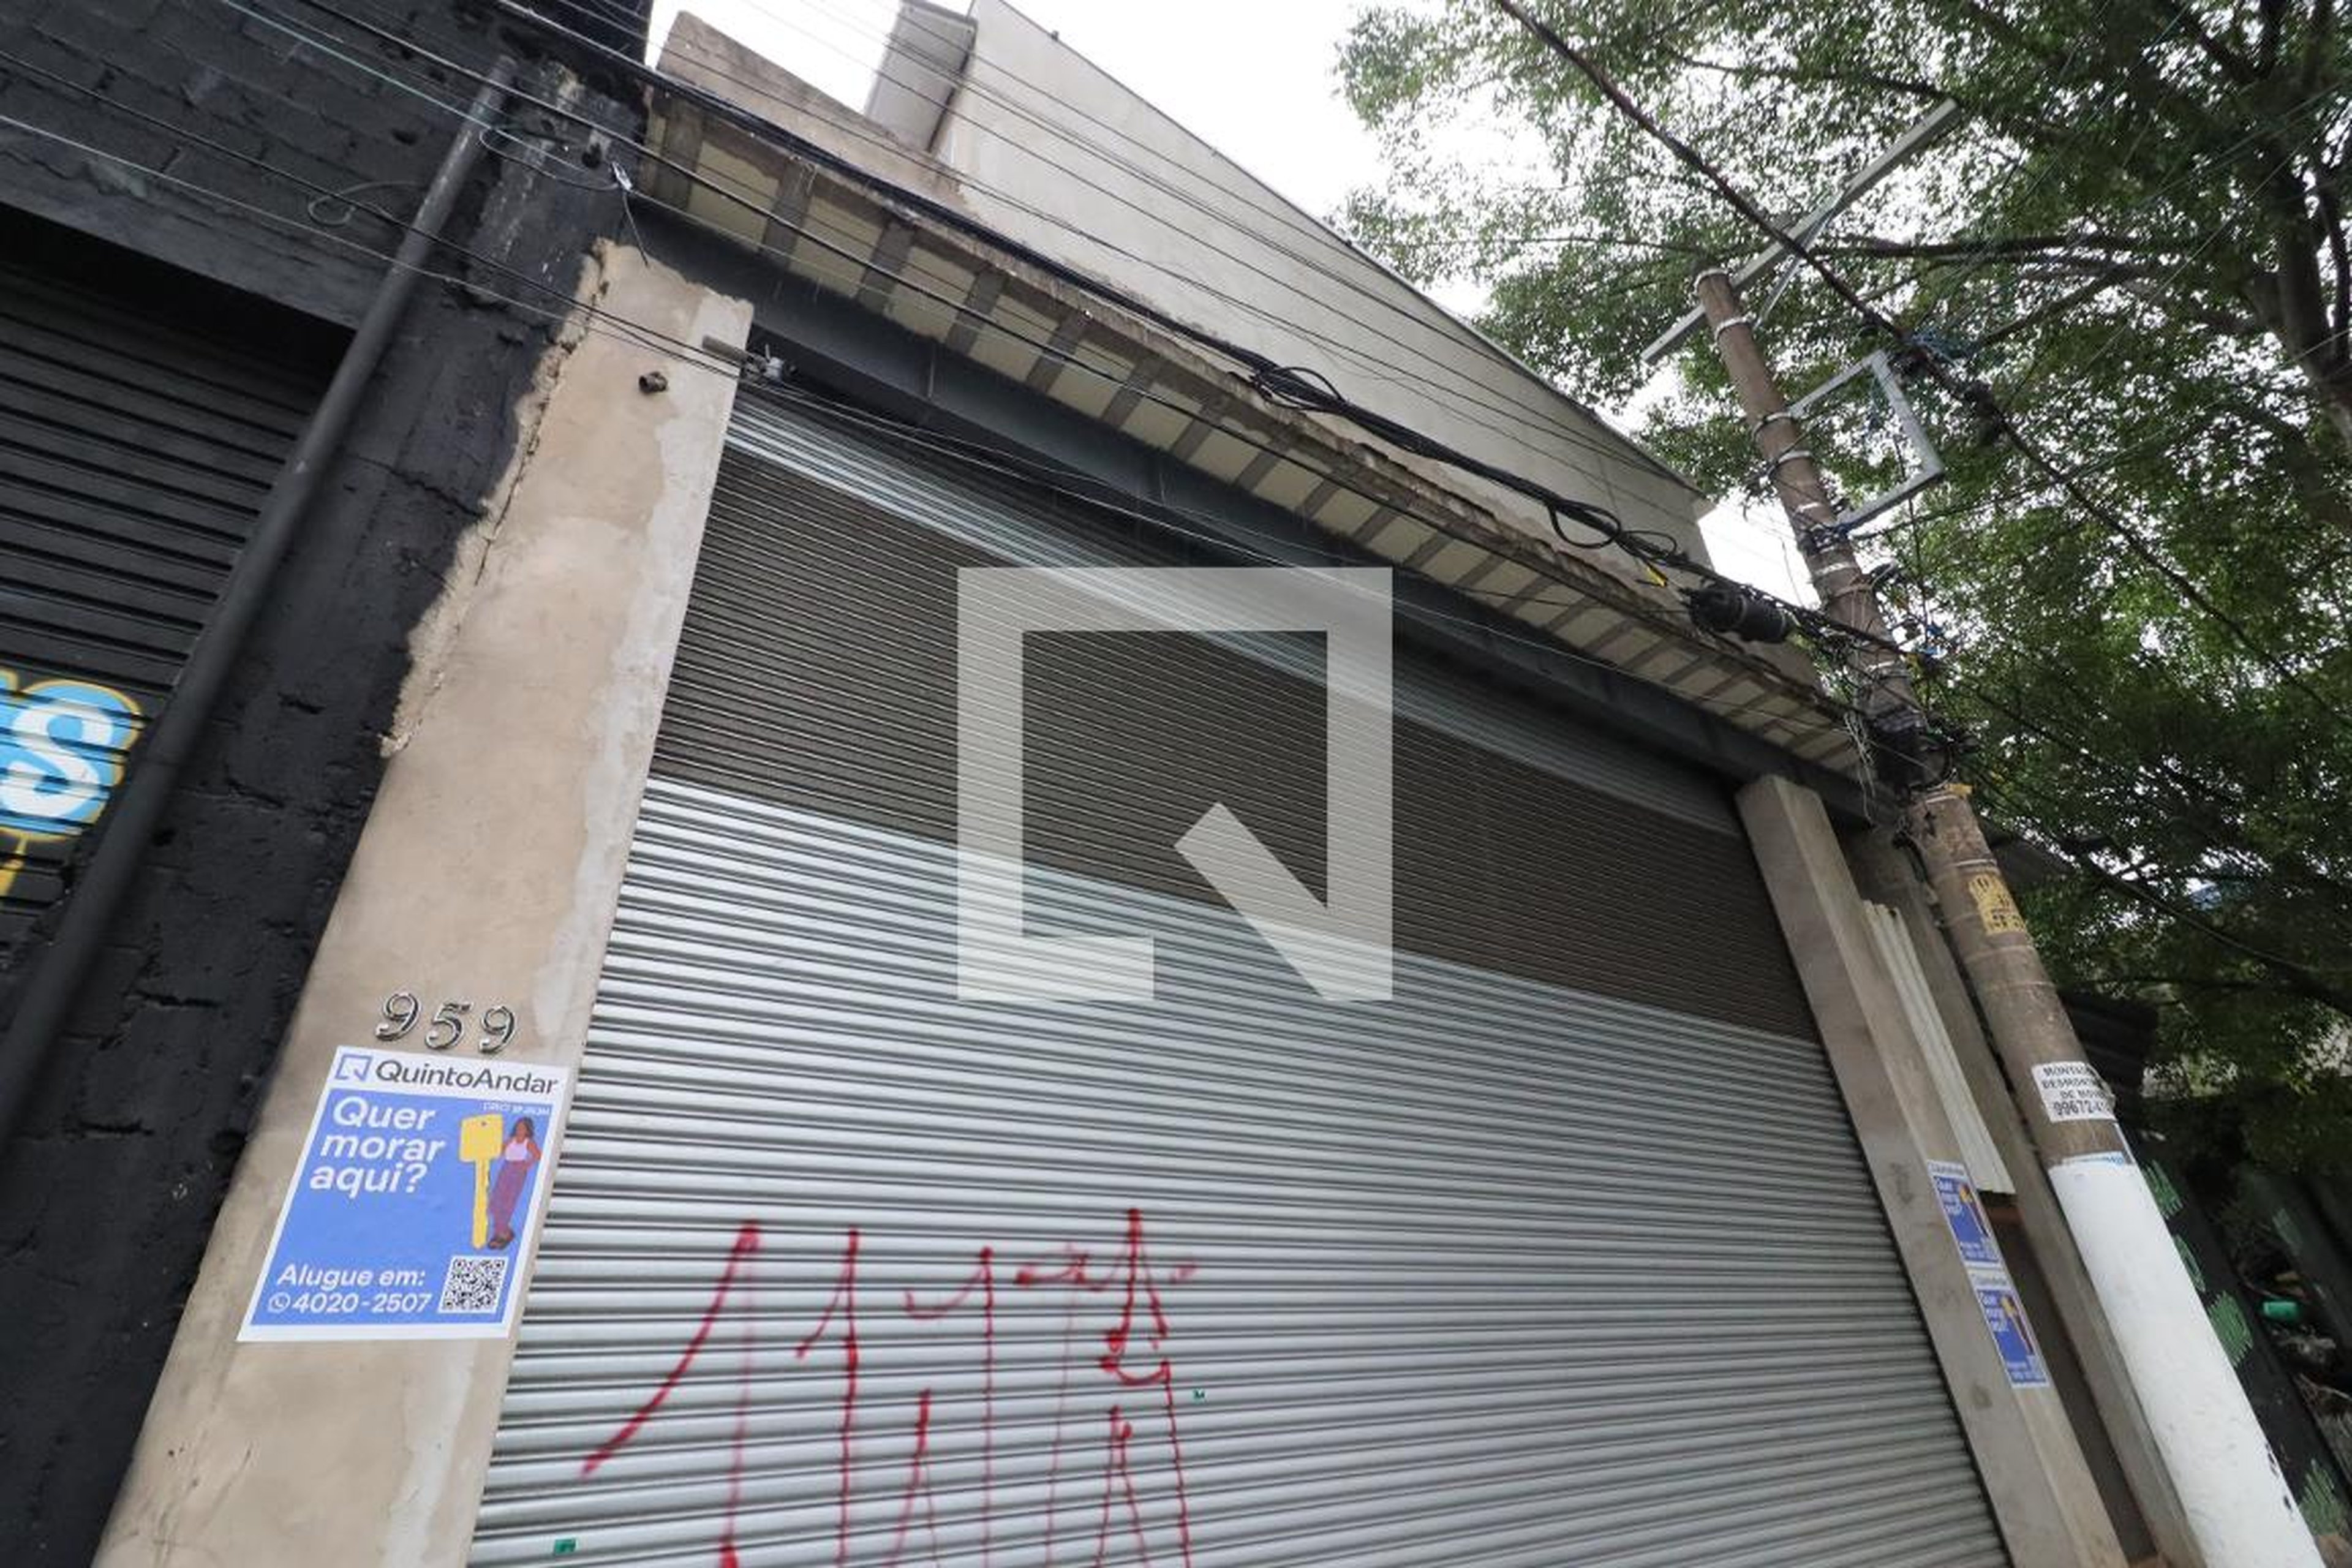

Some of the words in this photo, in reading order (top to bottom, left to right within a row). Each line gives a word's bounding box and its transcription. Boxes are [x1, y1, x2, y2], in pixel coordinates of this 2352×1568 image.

[375, 992, 517, 1055] 959
[374, 1059, 559, 1095] QuintoAndar
[333, 1095, 435, 1131] Quer
[319, 1134, 445, 1163] morar
[310, 1163, 428, 1199] aqui?
[276, 1262, 373, 1291] Alugue
[379, 1268, 426, 1286] em:
[292, 1292, 432, 1314] 4020-2507
